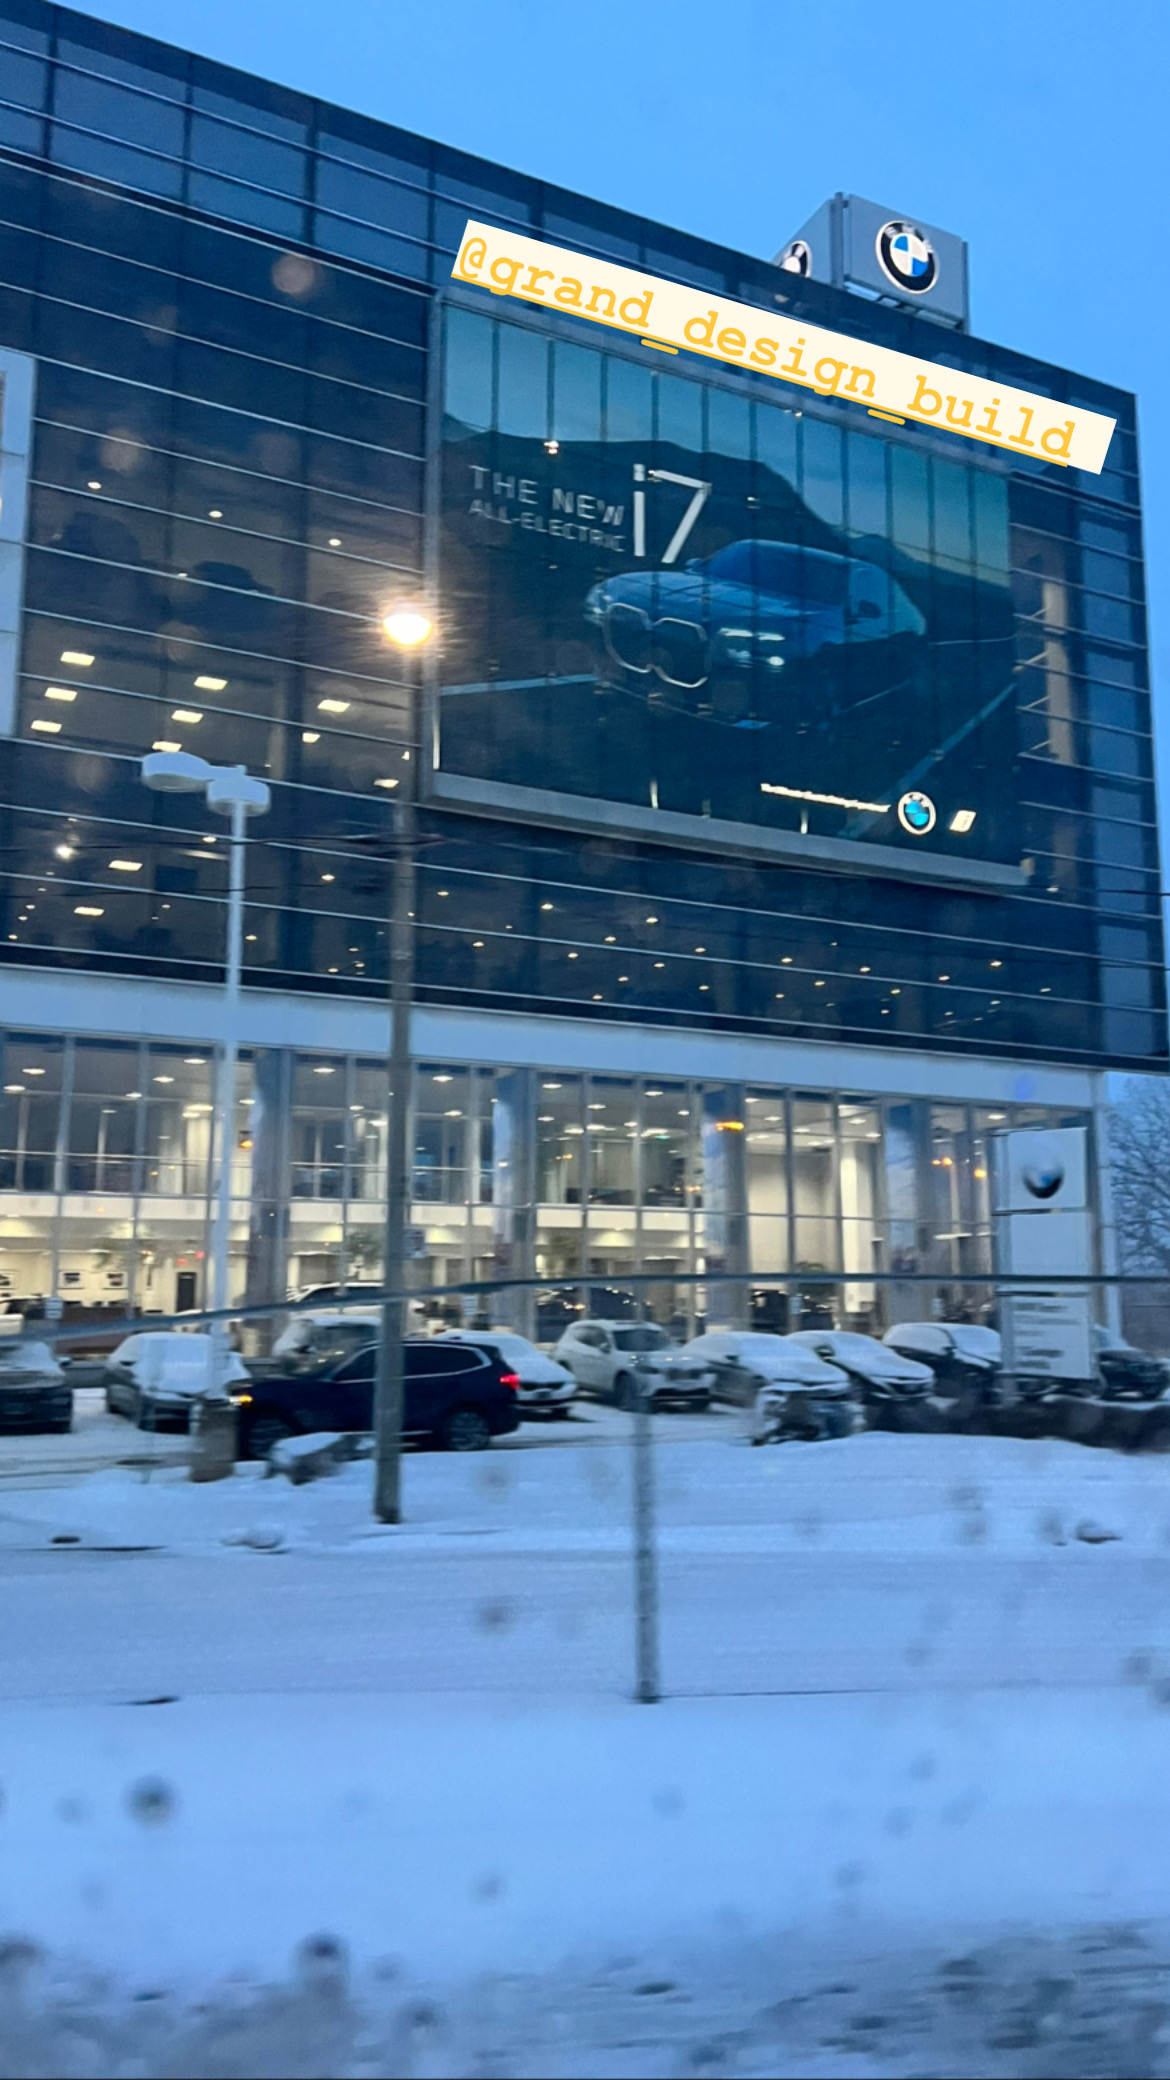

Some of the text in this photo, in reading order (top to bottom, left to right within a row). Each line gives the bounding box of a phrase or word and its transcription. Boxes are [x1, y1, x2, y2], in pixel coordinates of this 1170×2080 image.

[468, 464, 625, 527] THE NEW
[468, 498, 626, 553] ALL-ELECTRIC
[632, 462, 712, 564] i7
